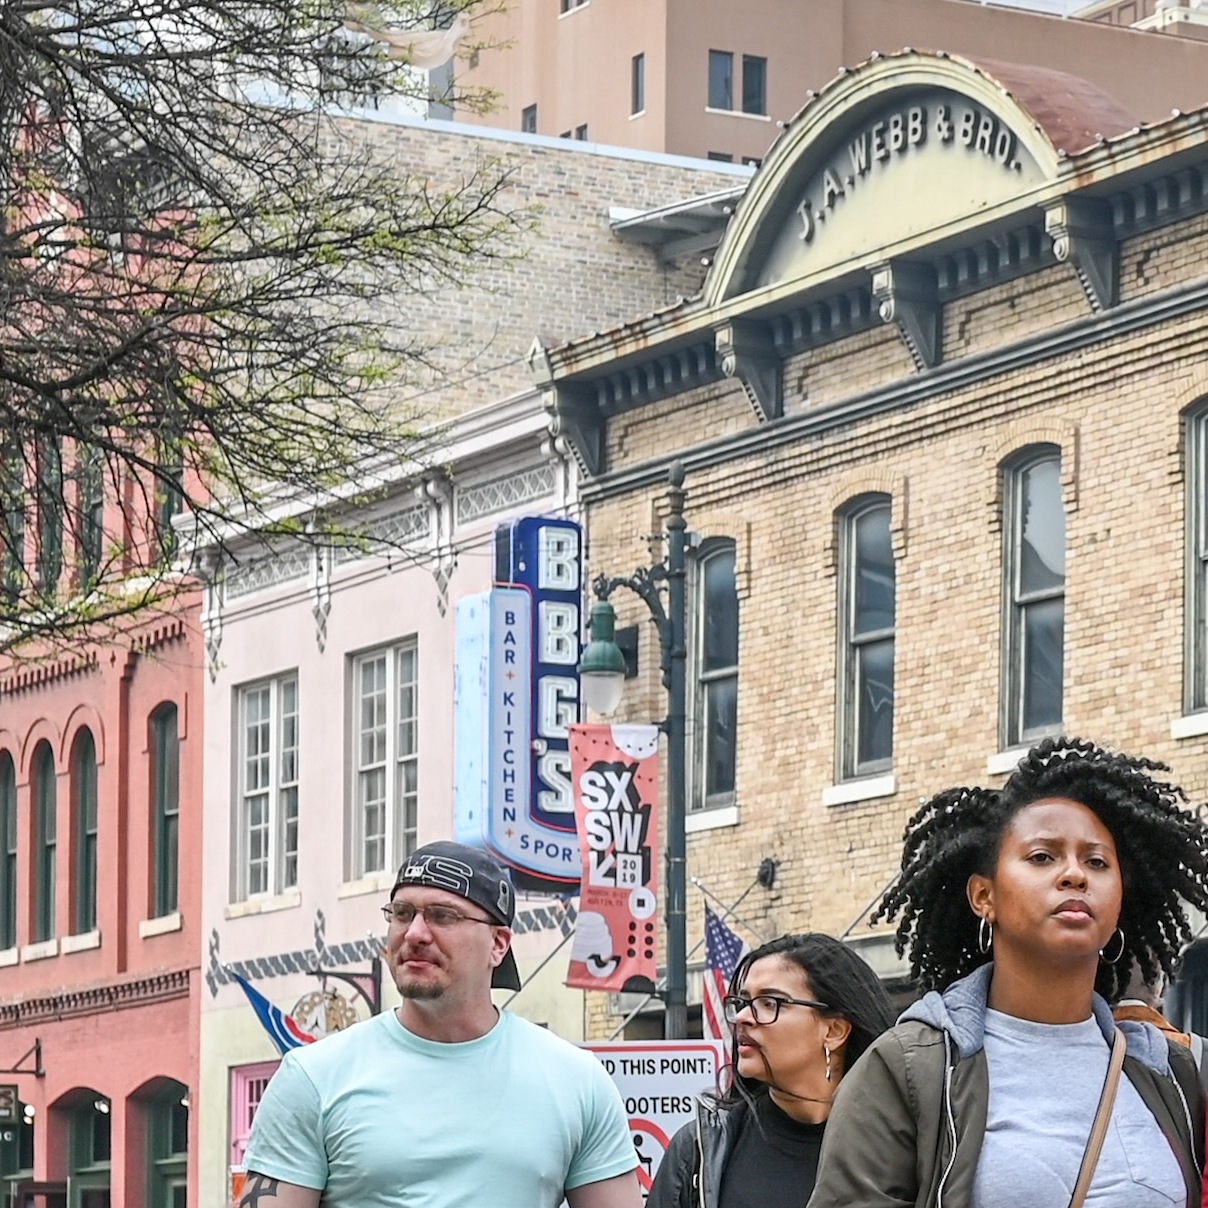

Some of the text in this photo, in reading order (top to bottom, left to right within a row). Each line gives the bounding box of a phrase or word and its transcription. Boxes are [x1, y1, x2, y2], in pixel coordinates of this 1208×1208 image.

[934, 104, 953, 141] &
[961, 107, 1020, 170] BRO.
[504, 611, 516, 664] BAR
[503, 692, 516, 822] KITCHEN
[520, 834, 581, 863] SPOR
[620, 1059, 656, 1075] THIS
[660, 1058, 711, 1075] POINT:
[621, 1096, 692, 1114] OOTERS
